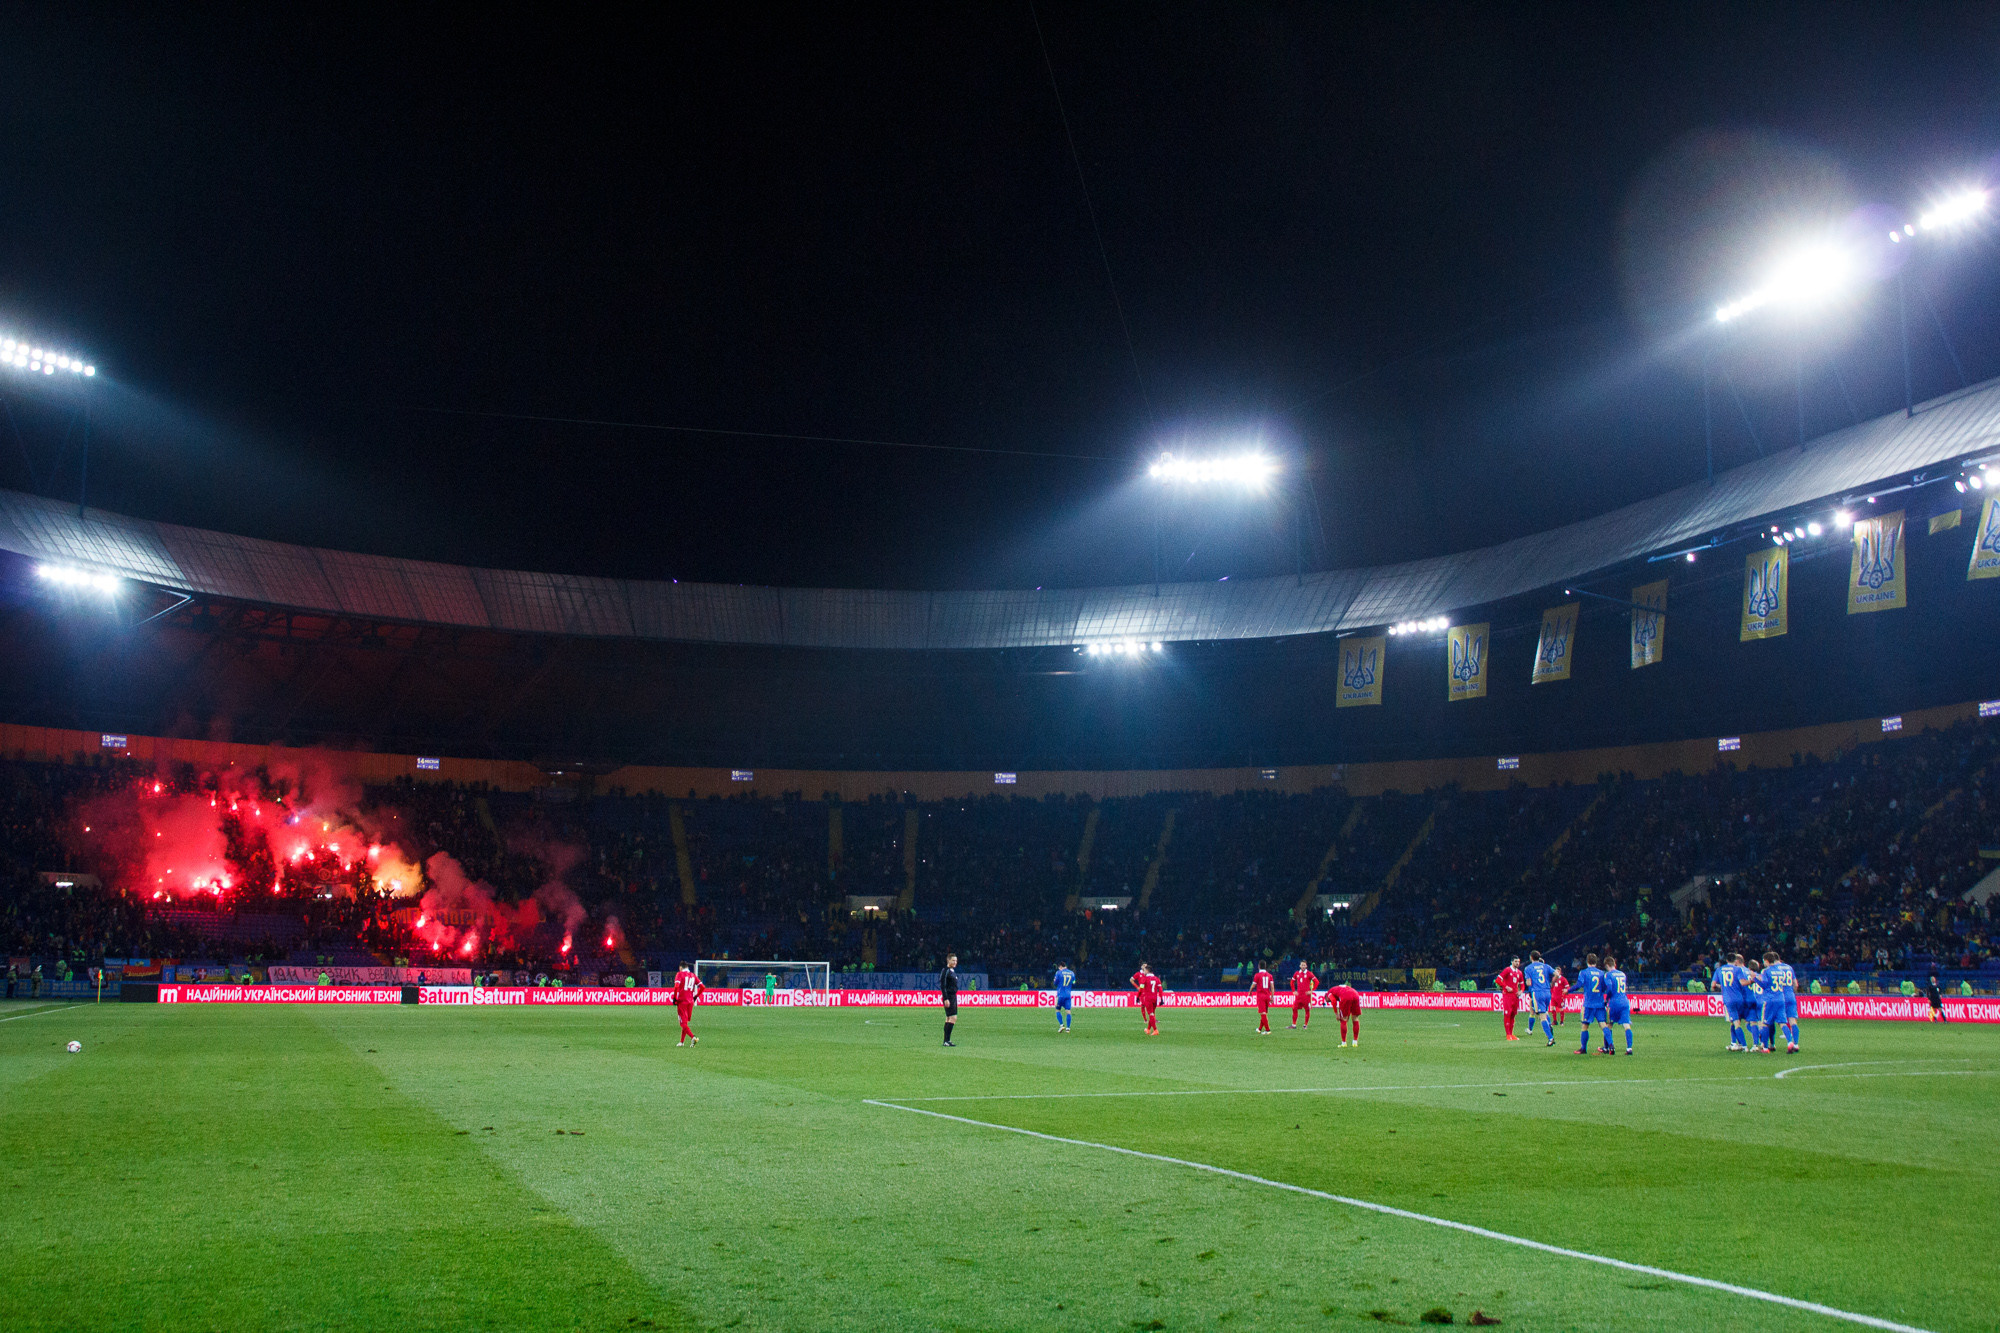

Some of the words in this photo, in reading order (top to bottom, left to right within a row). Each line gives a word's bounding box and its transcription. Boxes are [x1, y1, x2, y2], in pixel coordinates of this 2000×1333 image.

[1855, 590, 1896, 604] UKRAINE
[1747, 618, 1780, 631] UKRAINE
[1343, 691, 1373, 700] UKRAINE
[684, 976, 695, 991] 14
[1063, 974, 1072, 986] 17
[1262, 976, 1269, 988] 11
[1536, 969, 1545, 984] 3
[1721, 971, 1734, 987] 19
[1150, 980, 1156, 993] 7
[1591, 976, 1600, 993] 2
[1615, 977, 1626, 993] 15
[186, 987, 242, 1002] НАДІЙНИЙ
[244, 987, 316, 1002] УКРАЇНСЬКИЙ
[318, 990, 371, 1002] ВИРОБНИК
[419, 988, 469, 1004] Saturn
[473, 987, 525, 1004] Saturn
[533, 989, 583, 1003] НАДІЙНИЙ
[585, 989, 649, 1003] УКРАЇНСЬКИЙ
[703, 992, 739, 1004] ТЕХНІКИ
[848, 992, 893, 1005] НАДІЙНИЙ
[895, 992, 944, 1006] УКРАЇНСЬК
[956, 994, 1000, 1005] ВИРОБНИК
[1002, 994, 1035, 1005] ТЕХНІКИ
[1085, 991, 1128, 1008] Saturn
[1177, 994, 1230, 1007] УКРАЇНСЬКИЙ
[1382, 994, 1408, 1007] НАДІЙНИЙ
[1409, 994, 1444, 1008] УКРАЇНСЬКИЙ
[1444, 996, 1470, 1008] ВИРОБНИК
[1470, 997, 1491, 1009] ТЕХНІКИ
[1639, 998, 1675, 1012] ВИРОБНИК
[1676, 999, 1706, 1013] ТЕХНІКИ
[1800, 998, 1846, 1016] НАДІЙНИЙ
[1847, 998, 1912, 1018] УКРАЇНСЬКИЙ
